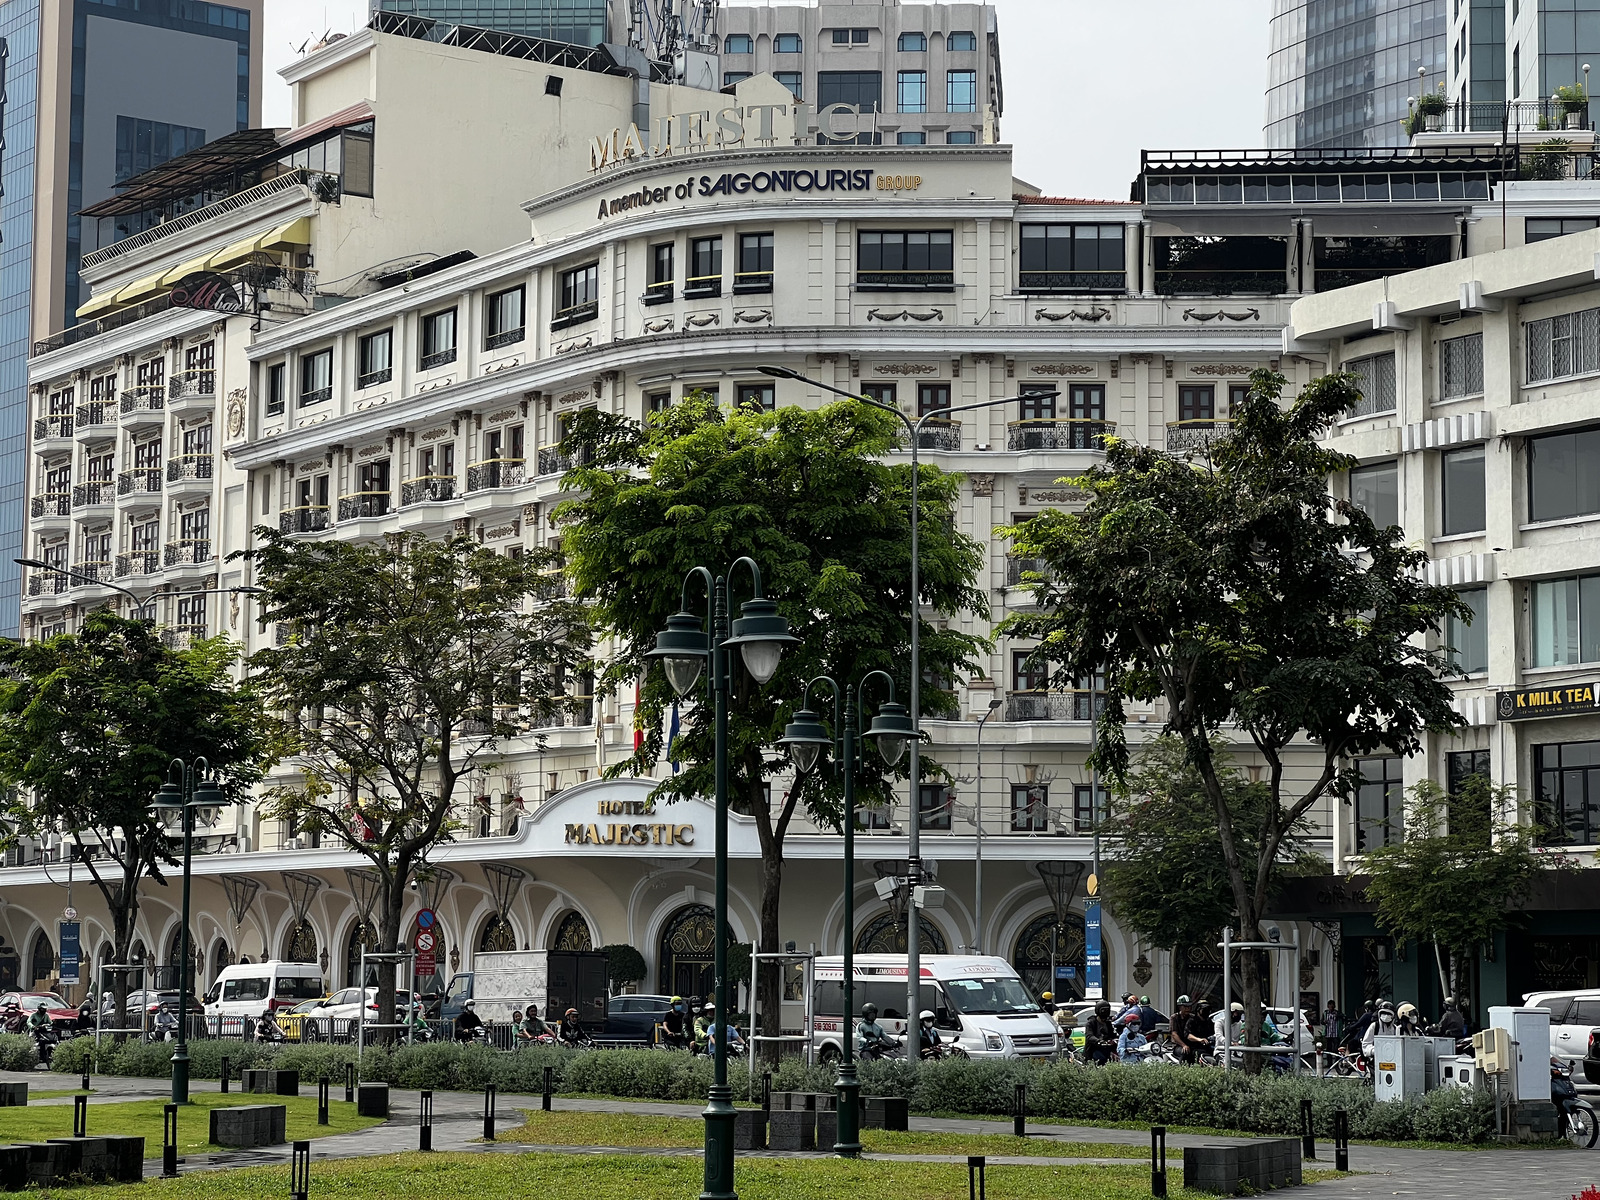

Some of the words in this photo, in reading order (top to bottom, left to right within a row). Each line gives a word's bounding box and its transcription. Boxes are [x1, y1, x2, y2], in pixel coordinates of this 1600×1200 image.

[588, 102, 861, 172] MAJESTIC
[597, 198, 610, 220] A
[610, 185, 672, 214] member
[674, 176, 696, 200] of
[697, 168, 874, 197] SAIGONTOURIST
[876, 174, 923, 191] GROUP
[1516, 694, 1526, 707] K
[1529, 690, 1562, 706] MILK
[1566, 687, 1593, 702] TEA
[597, 800, 656, 816] HOTEL
[564, 822, 695, 847] MAJESTIC
